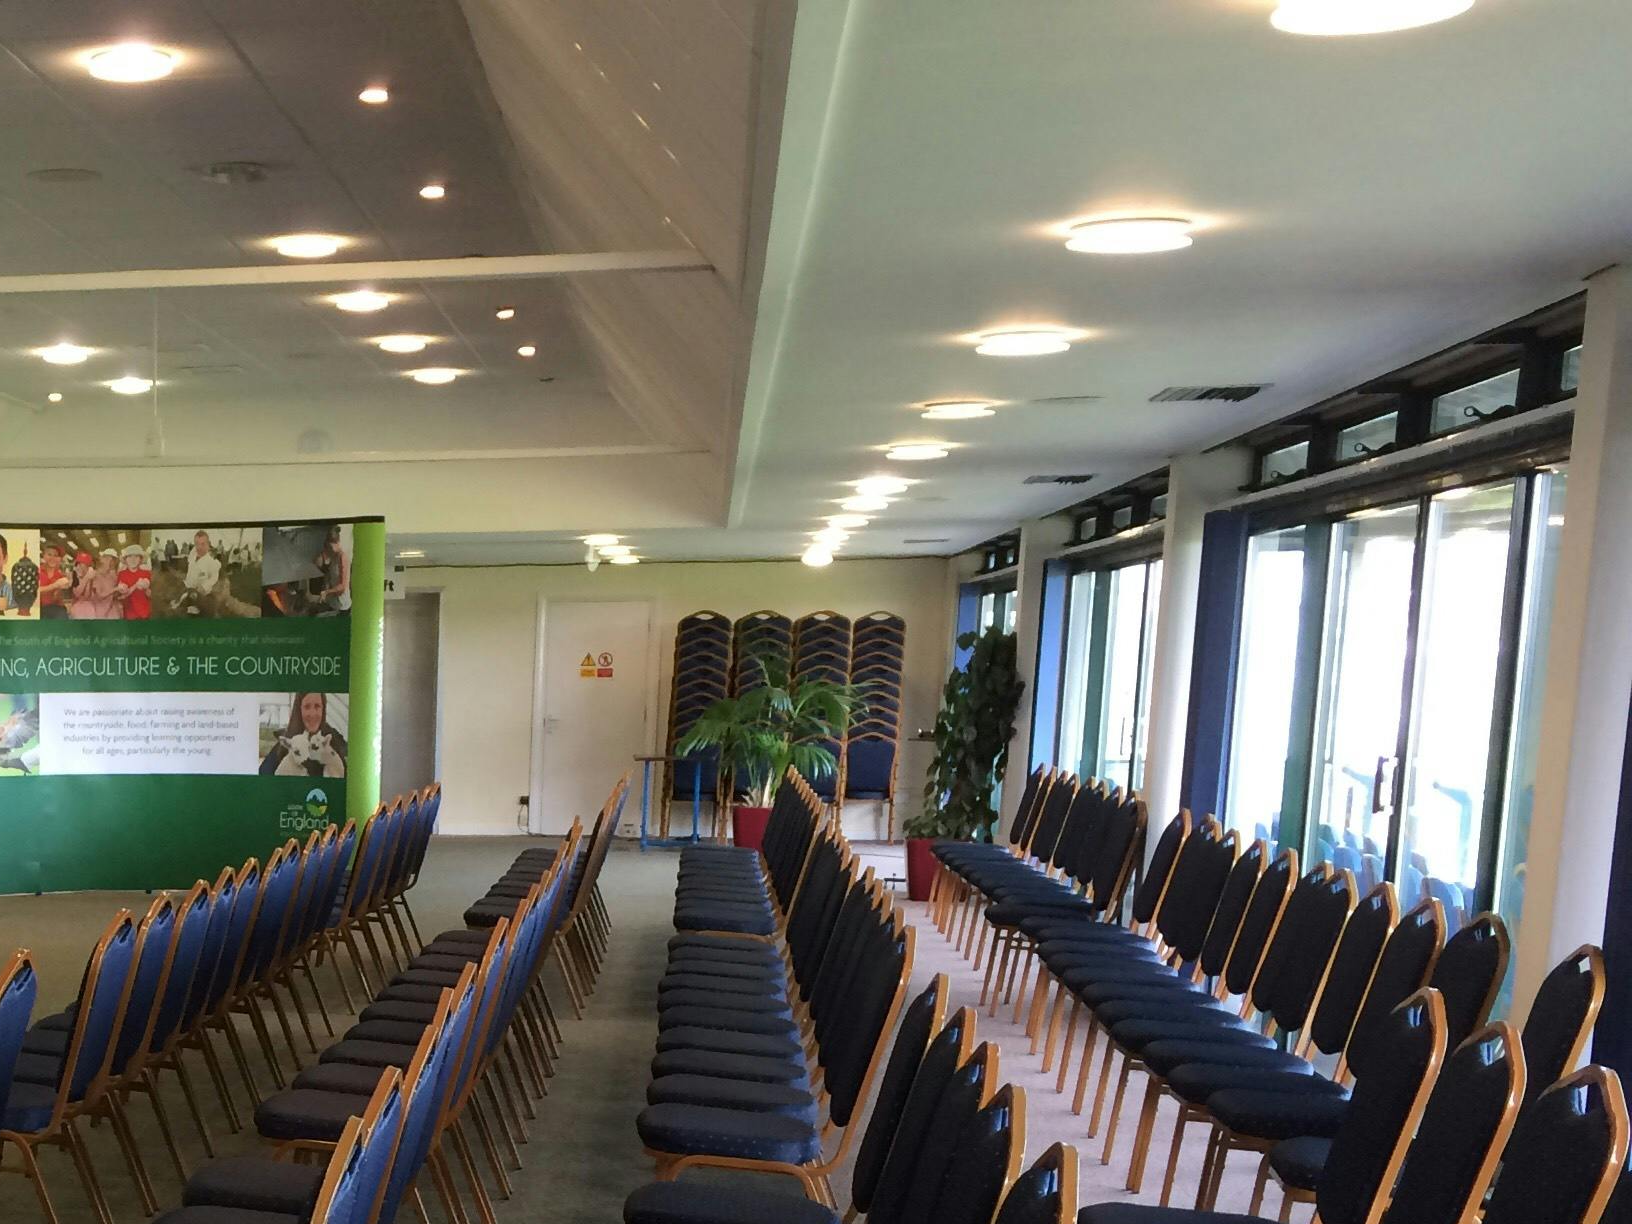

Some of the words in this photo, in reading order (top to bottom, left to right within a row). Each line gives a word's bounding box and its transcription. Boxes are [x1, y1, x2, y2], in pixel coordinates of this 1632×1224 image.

[54, 635, 90, 648] England
[93, 635, 147, 648] Agricultural
[150, 635, 186, 648] Society
[35, 657, 160, 677] AGRICULTURE
[167, 656, 180, 676] &
[187, 656, 219, 676] THE
[225, 656, 341, 676] COUNTRYSIDE
[63, 708, 76, 716] We
[92, 708, 134, 718] passionate
[135, 708, 158, 716] about
[160, 708, 185, 718] raising
[226, 708, 236, 716] of
[63, 720, 76, 729] the
[150, 720, 181, 730] farming
[182, 720, 196, 729] and
[197, 720, 239, 729] land-based
[63, 733, 100, 742] industries
[101, 733, 111, 744] by
[113, 733, 150, 744] providing
[151, 733, 182, 744] learning
[184, 733, 236, 744] opportunities
[82, 746, 94, 755] for
[95, 746, 105, 755] all
[127, 746, 171, 757] particularly
[172, 746, 186, 755] the
[279, 811, 330, 831] England
